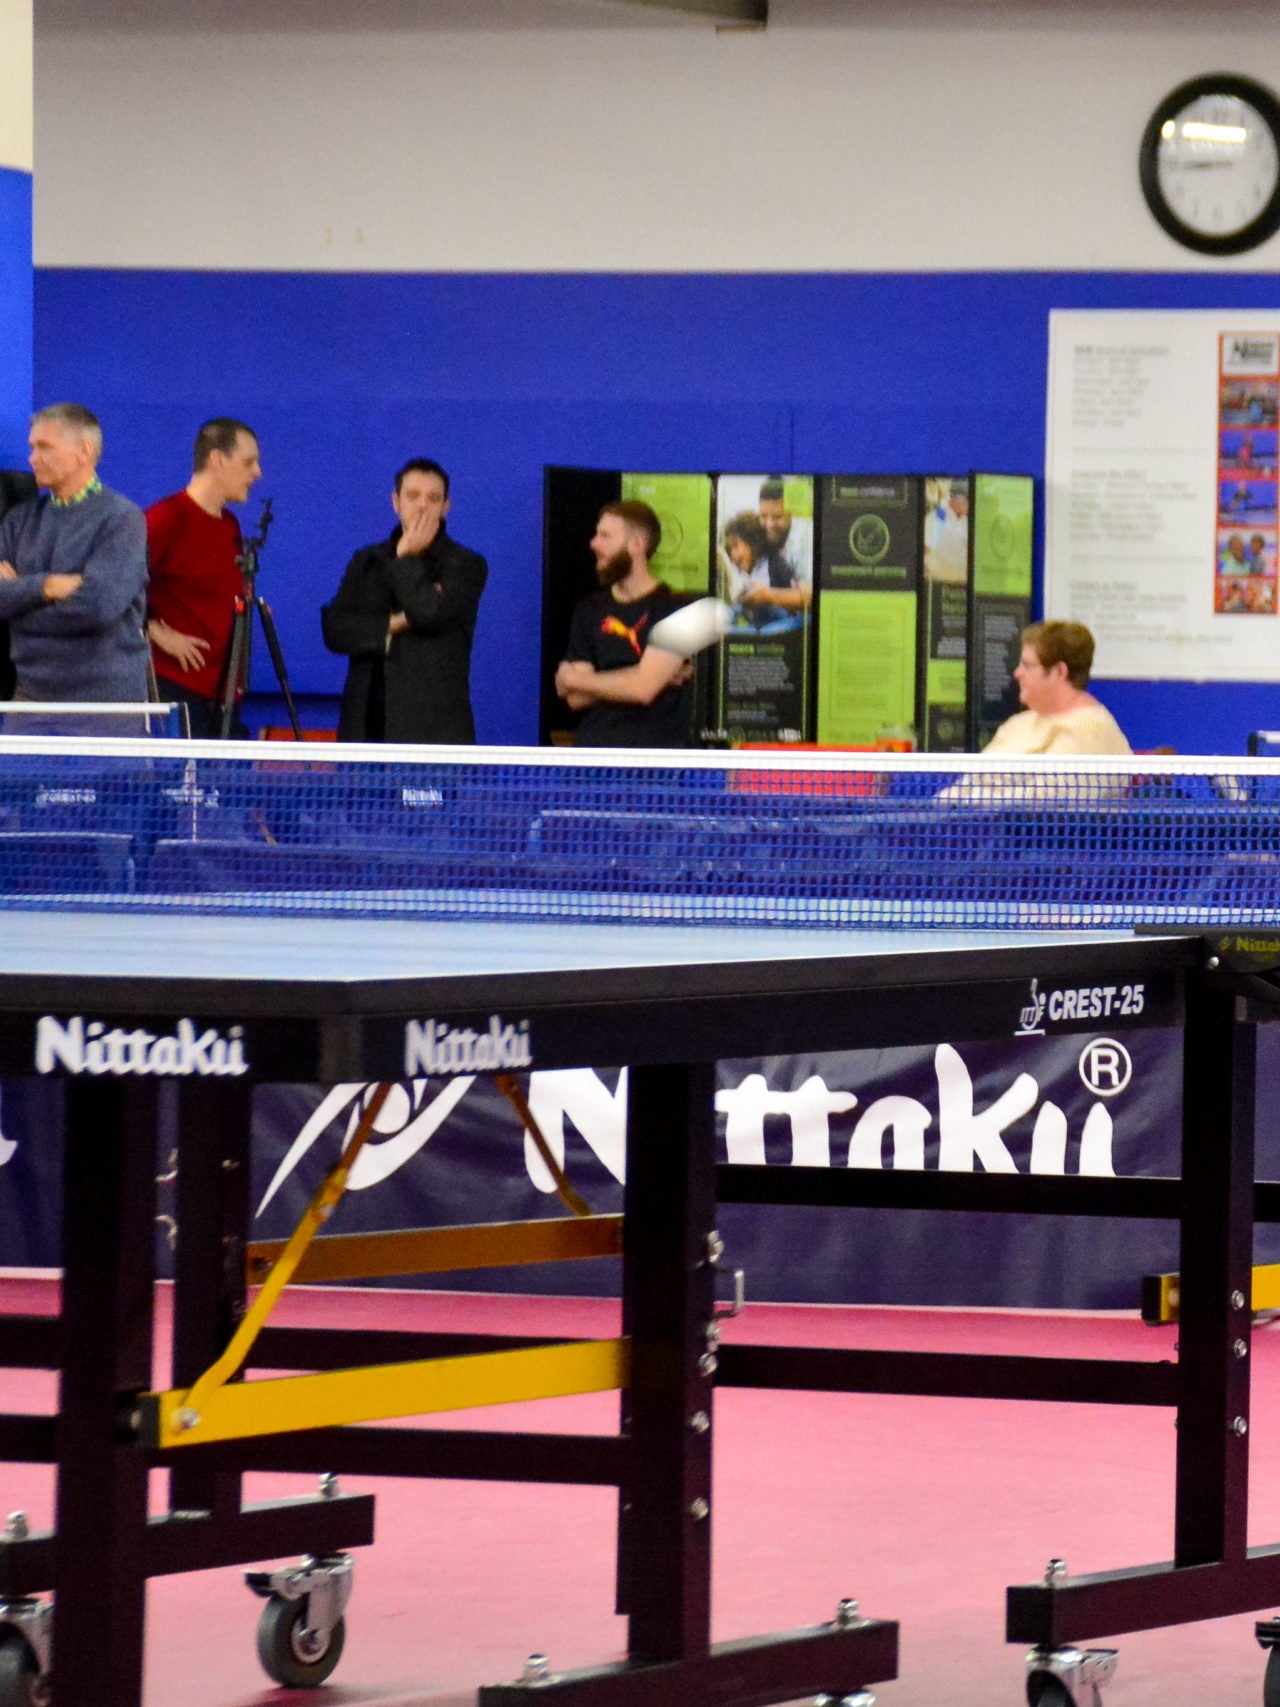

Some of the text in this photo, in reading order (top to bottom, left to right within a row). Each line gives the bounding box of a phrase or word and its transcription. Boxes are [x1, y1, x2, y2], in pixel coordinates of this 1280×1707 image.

[1049, 984, 1145, 1021] CREST-25
[35, 1015, 249, 1076] Nittaku
[404, 1014, 533, 1077] Nittaku
[524, 1043, 1116, 1194] Nttaku
